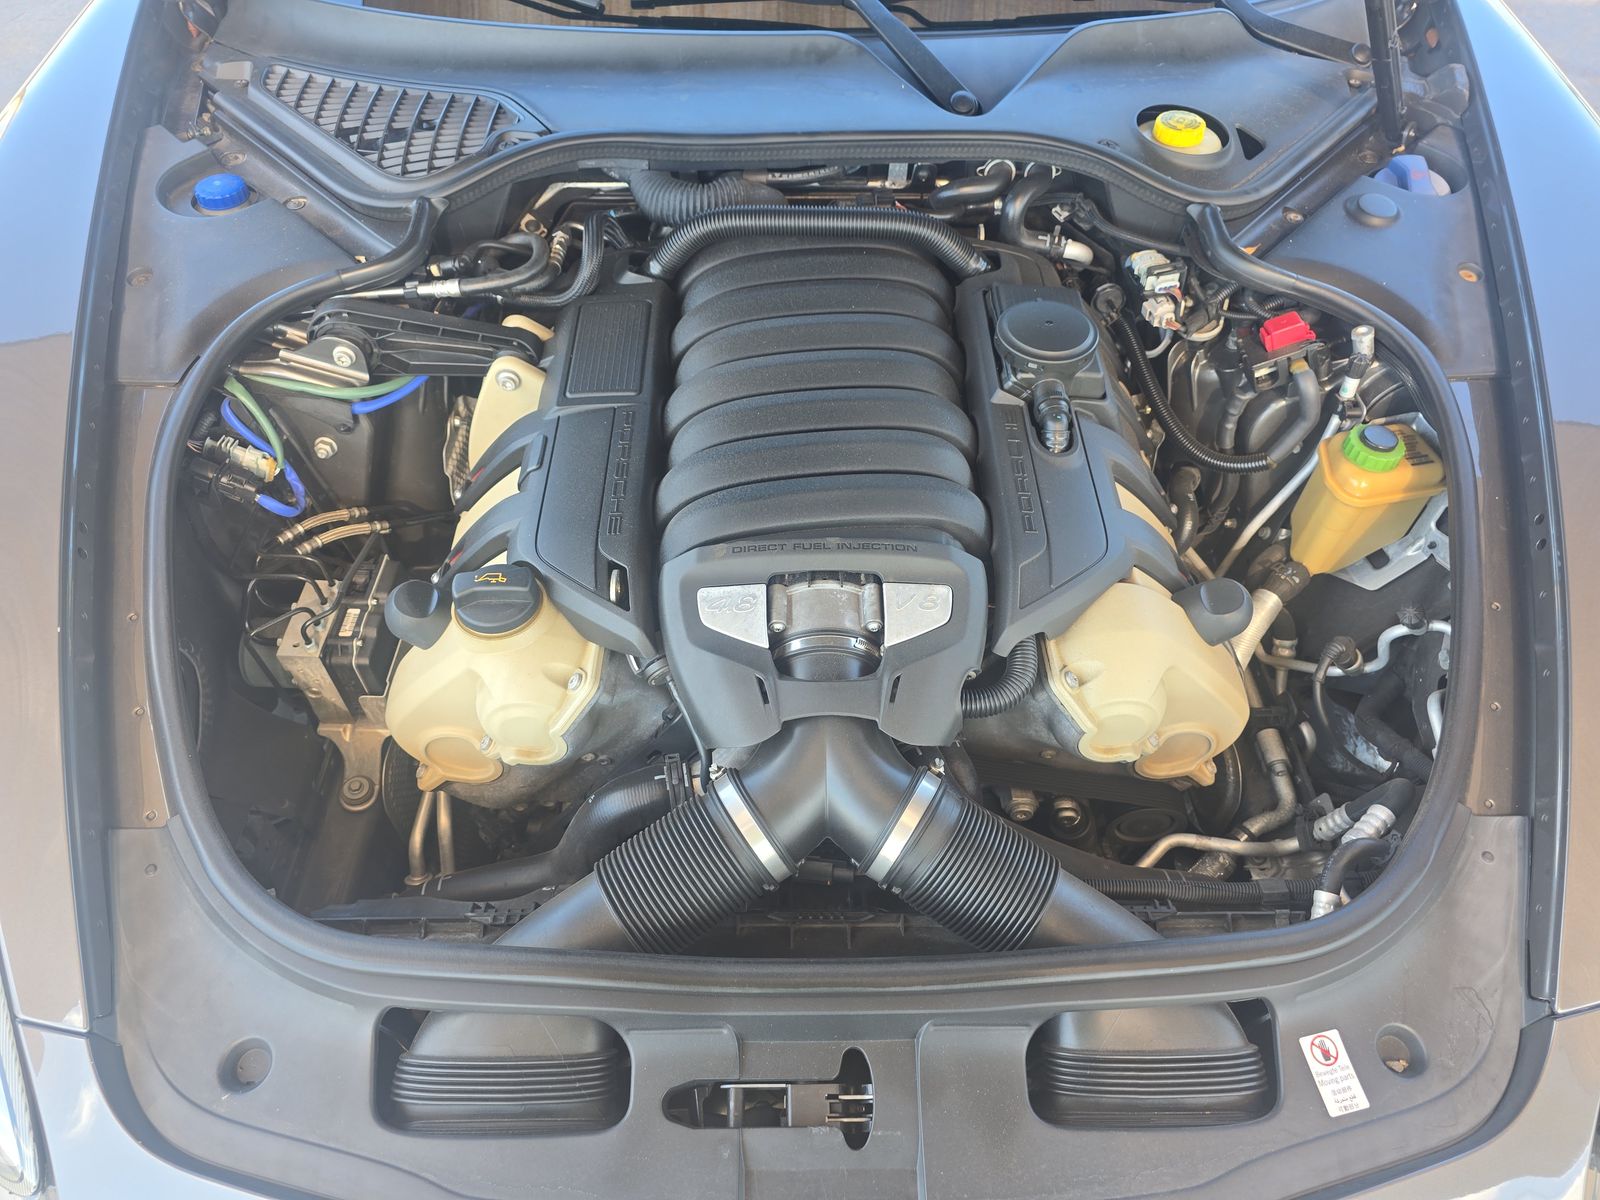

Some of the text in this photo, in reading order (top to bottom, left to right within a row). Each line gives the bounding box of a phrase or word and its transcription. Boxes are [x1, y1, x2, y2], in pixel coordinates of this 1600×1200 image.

[606, 411, 634, 535] PORSCHE
[731, 542, 918, 554] DIRECT FUEL INJECTION
[1318, 1073, 1355, 1087] Moving parts
